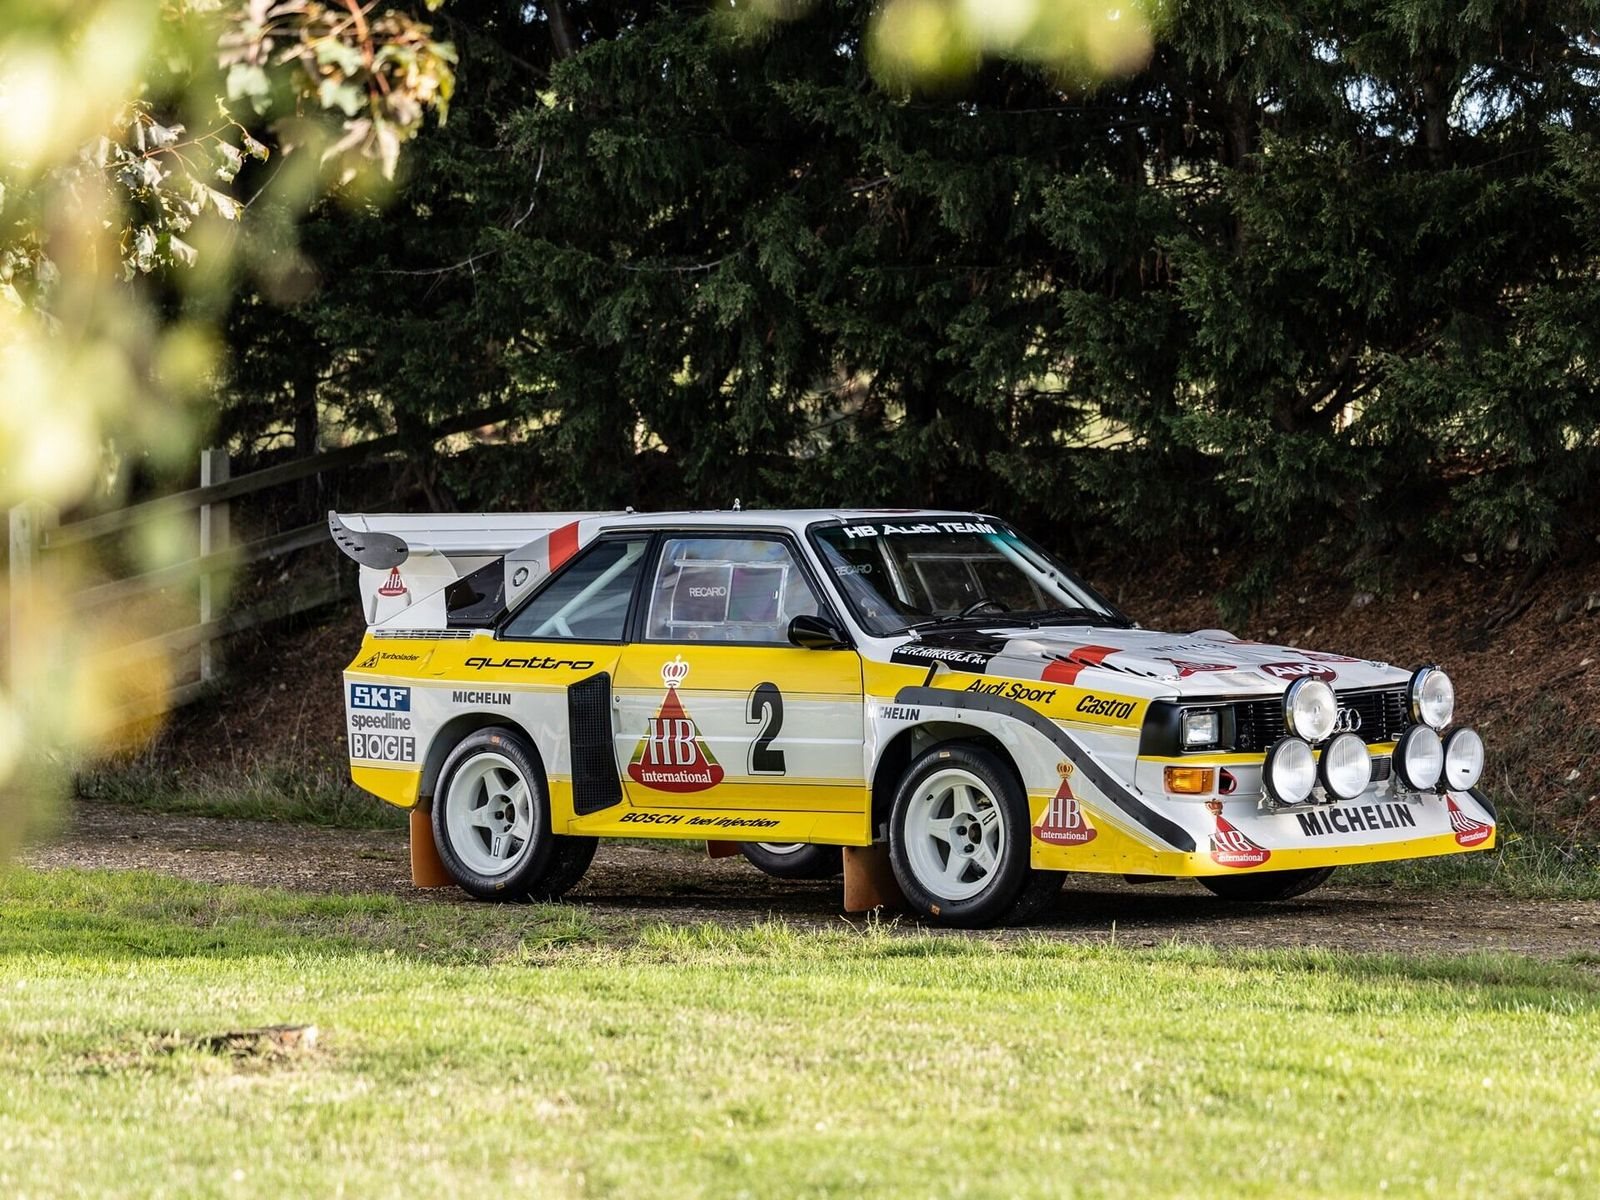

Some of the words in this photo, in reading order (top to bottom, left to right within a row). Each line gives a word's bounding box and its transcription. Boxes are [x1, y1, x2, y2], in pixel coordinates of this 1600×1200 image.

[842, 525, 879, 539] HB
[937, 522, 998, 535] TEAM
[688, 586, 727, 598] RECARO
[380, 652, 420, 661] Turbolader
[464, 656, 595, 670] quattro
[354, 686, 408, 709] SKF
[452, 690, 512, 705] MICHELIN
[964, 679, 1005, 696] Audi
[1005, 683, 1056, 704] Sport
[1076, 695, 1137, 720] Castrol
[351, 712, 411, 731] speedline
[745, 681, 787, 777] 2
[353, 734, 414, 761] BOGE
[648, 717, 697, 766] HB
[642, 769, 713, 784] international
[619, 812, 685, 824] BOSCH
[685, 816, 719, 826] fuel
[716, 816, 781, 828] injection
[1048, 798, 1081, 829] HB
[1296, 803, 1417, 837] MICHELIN
[1041, 829, 1088, 841] international
